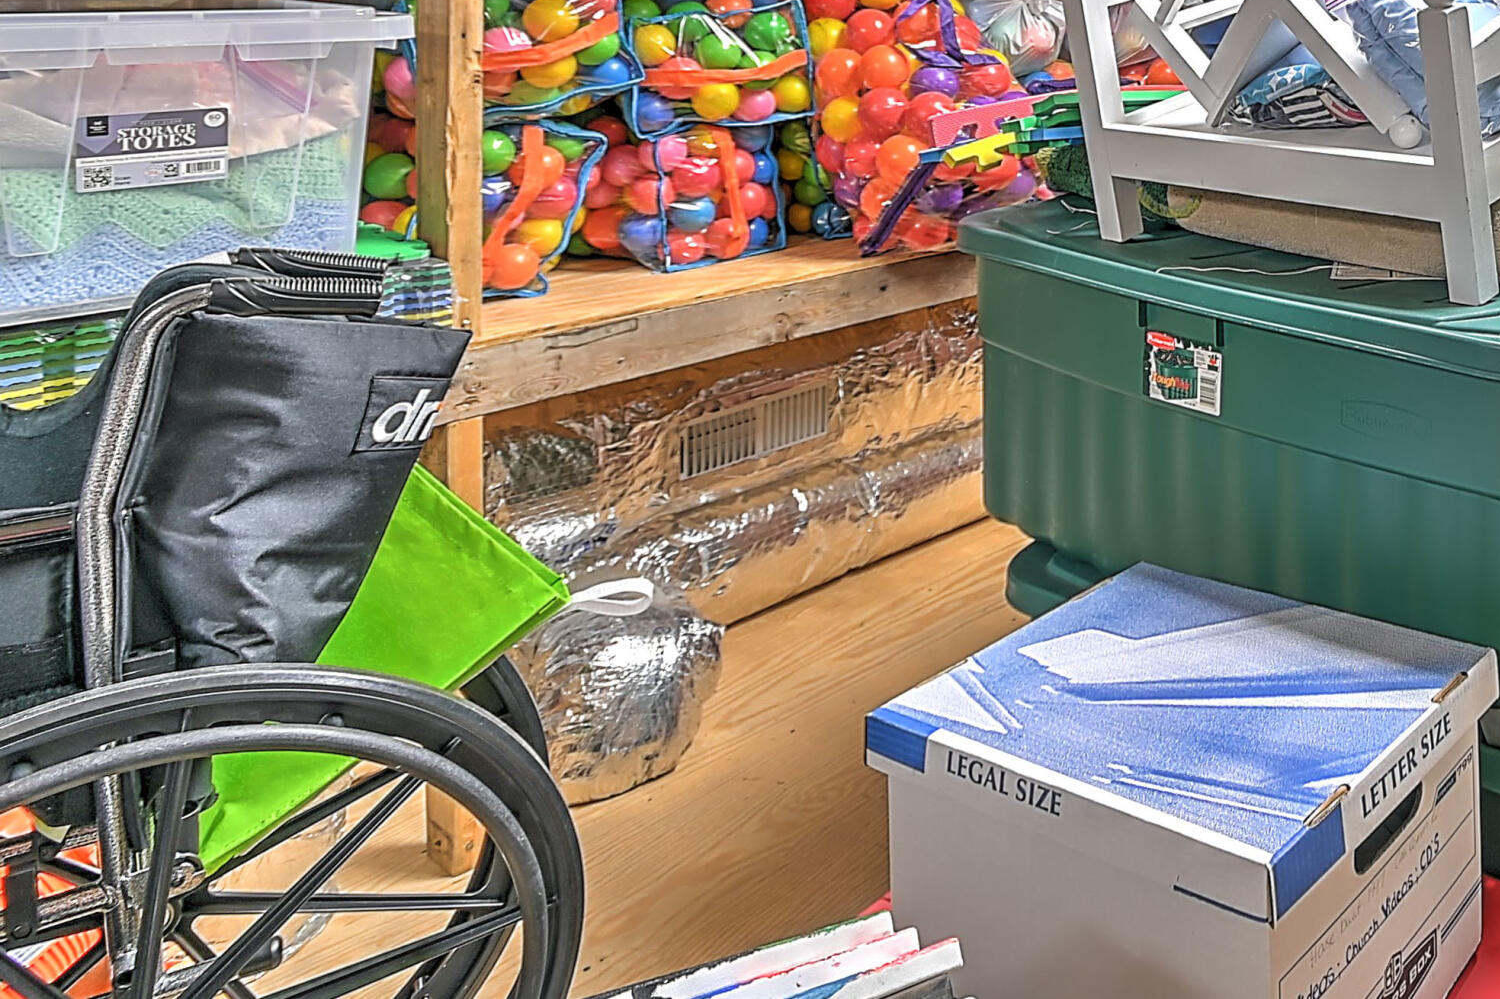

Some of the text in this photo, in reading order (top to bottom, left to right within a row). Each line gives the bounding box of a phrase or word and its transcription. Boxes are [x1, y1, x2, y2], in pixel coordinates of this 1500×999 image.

[117, 123, 196, 138] STORAGE
[117, 133, 197, 151] TOTES
[946, 750, 1062, 817] LEGAL SIZE
[1361, 747, 1418, 819] LETTER
[1420, 711, 1452, 759] SIZE
[1345, 918, 1380, 965] Church
[1408, 944, 1432, 985] BOX
